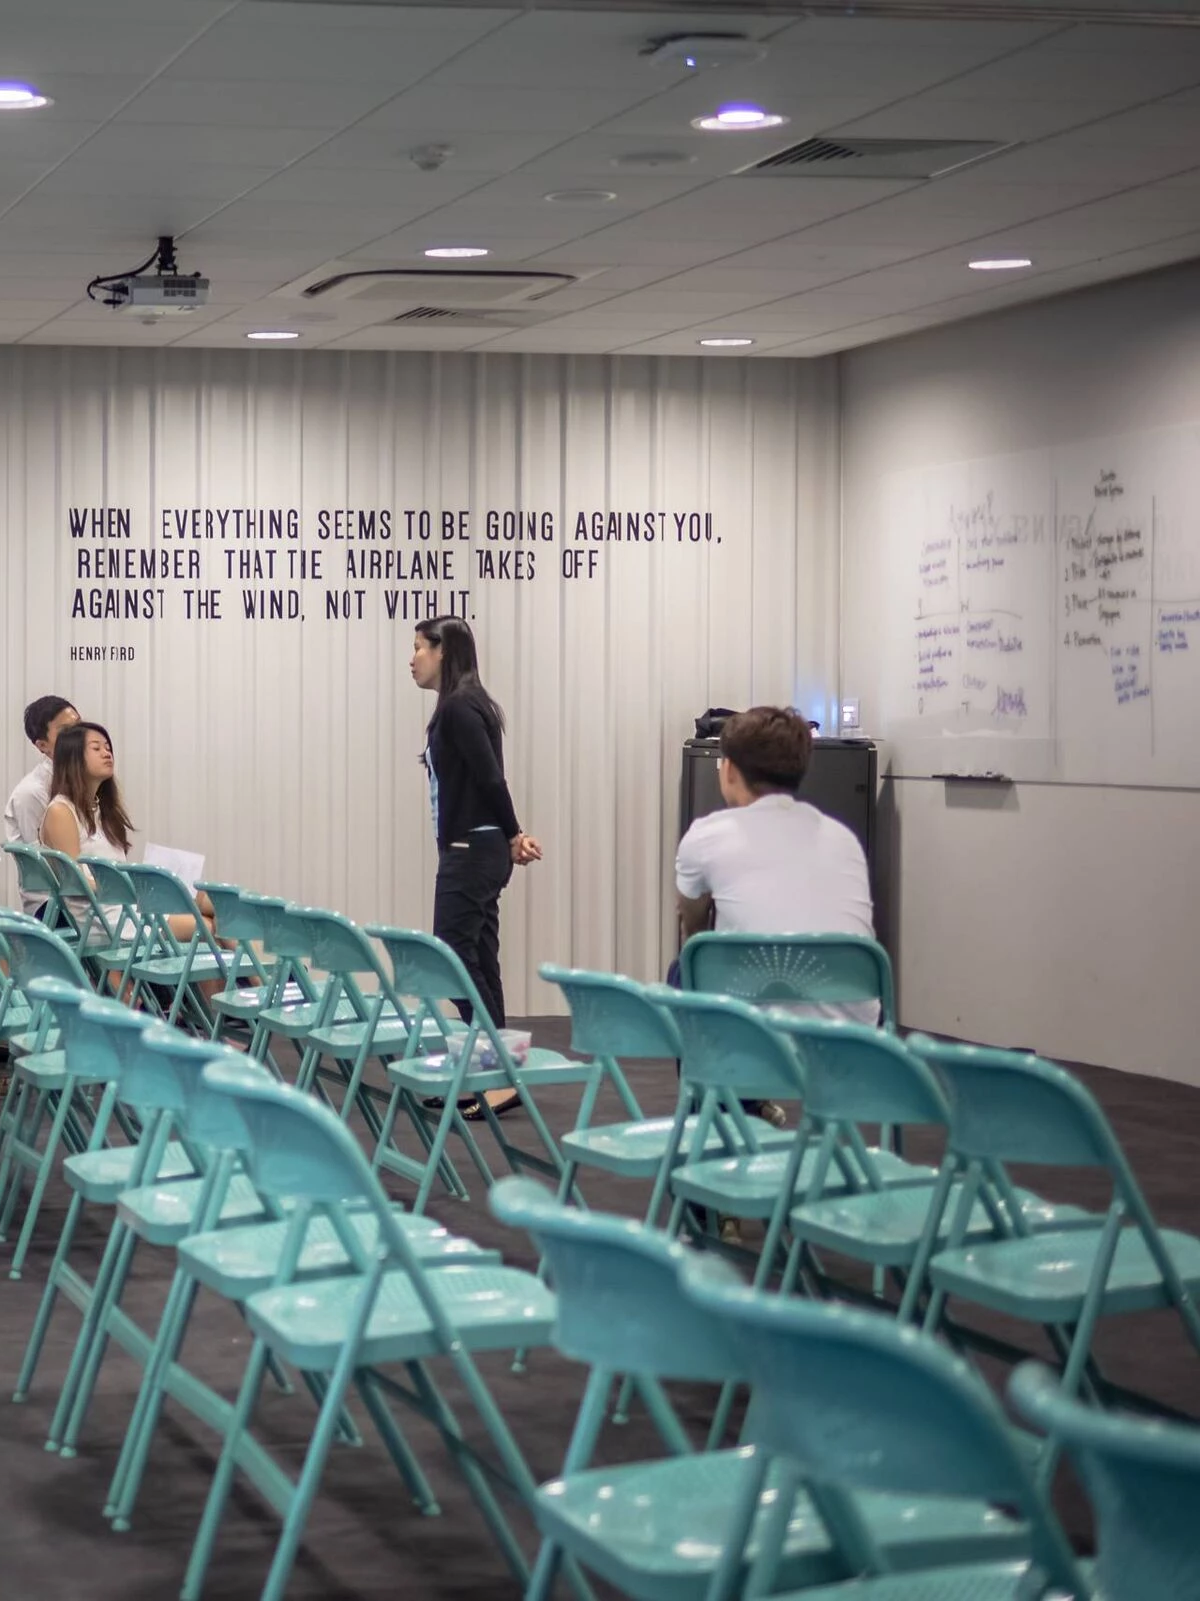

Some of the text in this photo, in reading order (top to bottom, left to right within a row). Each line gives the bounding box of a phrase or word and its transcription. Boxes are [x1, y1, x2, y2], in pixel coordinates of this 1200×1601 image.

[69, 508, 721, 543] WHEN EVERYTHING SEEMS TO BE GOING AGAINST YOU,
[78, 548, 199, 579] REMEMBER
[224, 550, 276, 579] THAT
[347, 549, 454, 580] AIRPLANE
[476, 550, 535, 580] TAKES
[562, 549, 598, 579] OFF
[72, 589, 475, 622] AGAINST THE WIND, NOT WITH IT.
[71, 647, 106, 660] HENRY
